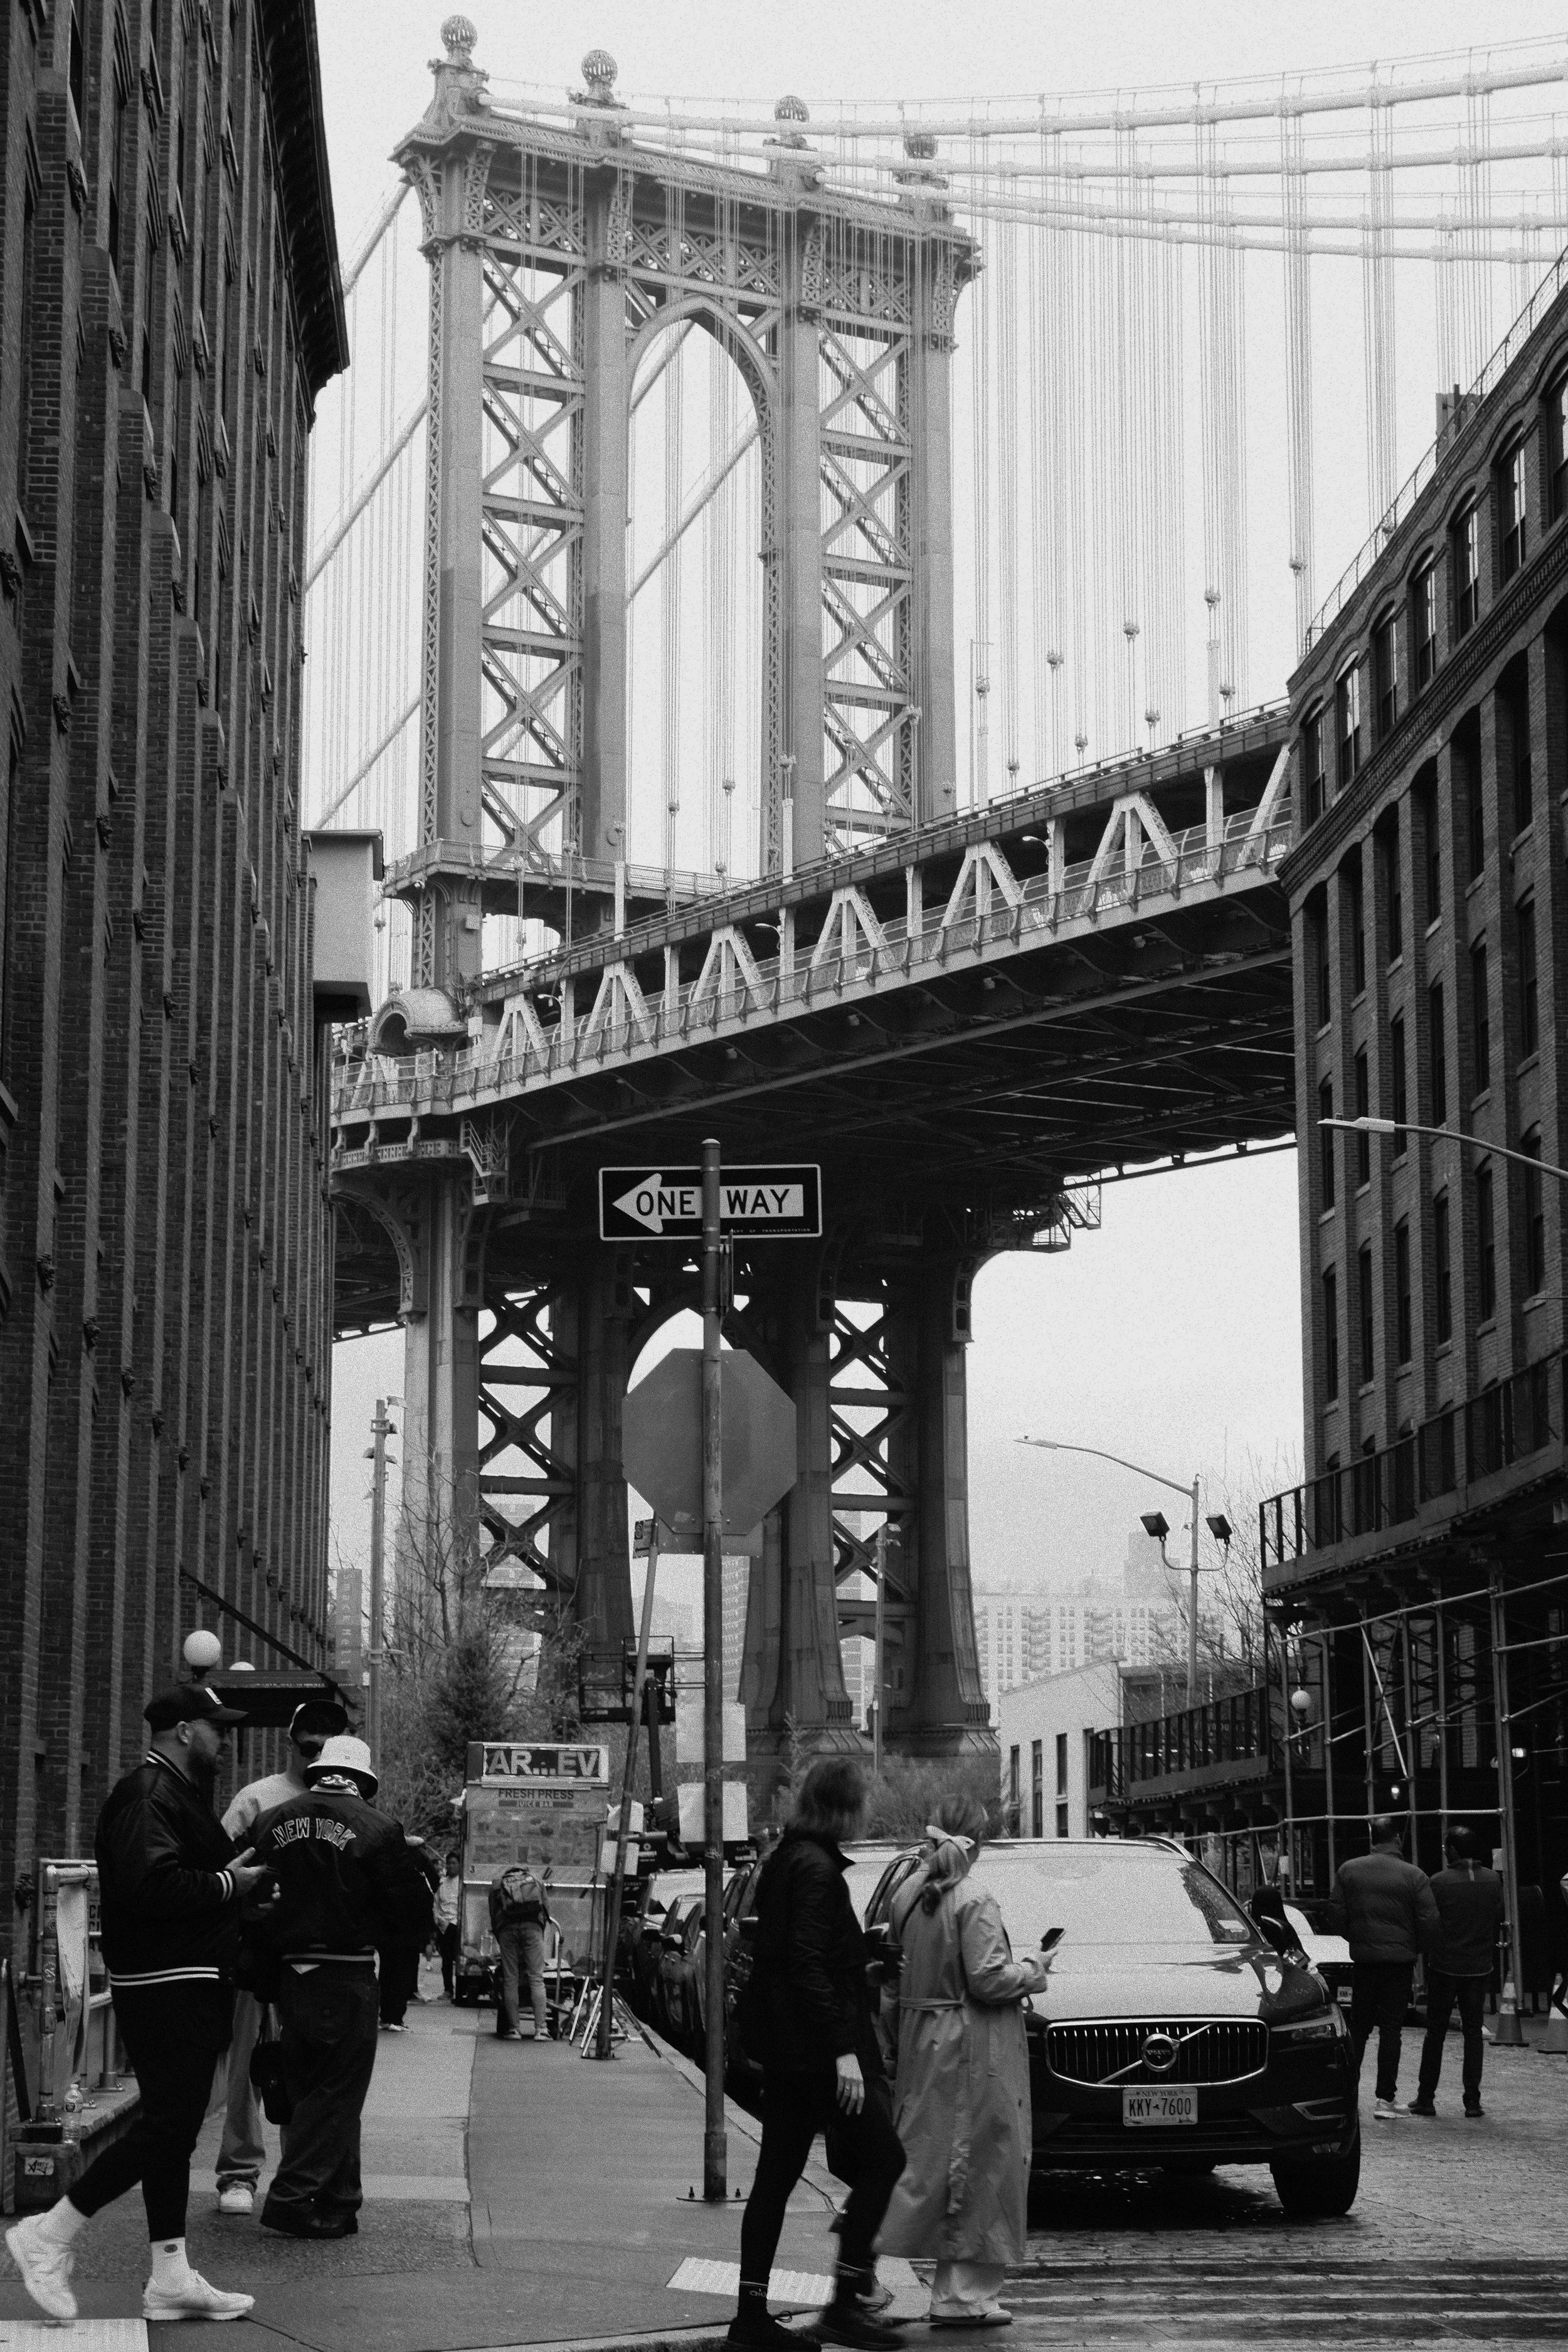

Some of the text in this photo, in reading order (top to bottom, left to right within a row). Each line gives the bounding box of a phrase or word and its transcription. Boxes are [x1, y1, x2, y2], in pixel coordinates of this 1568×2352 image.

[636, 1188, 790, 1216] ONE WAY
[499, 1789, 574, 1799] FRESH PRESS
[272, 1816, 357, 1851] NEW YORK
[1129, 2097, 1192, 2116] KKY 7600
